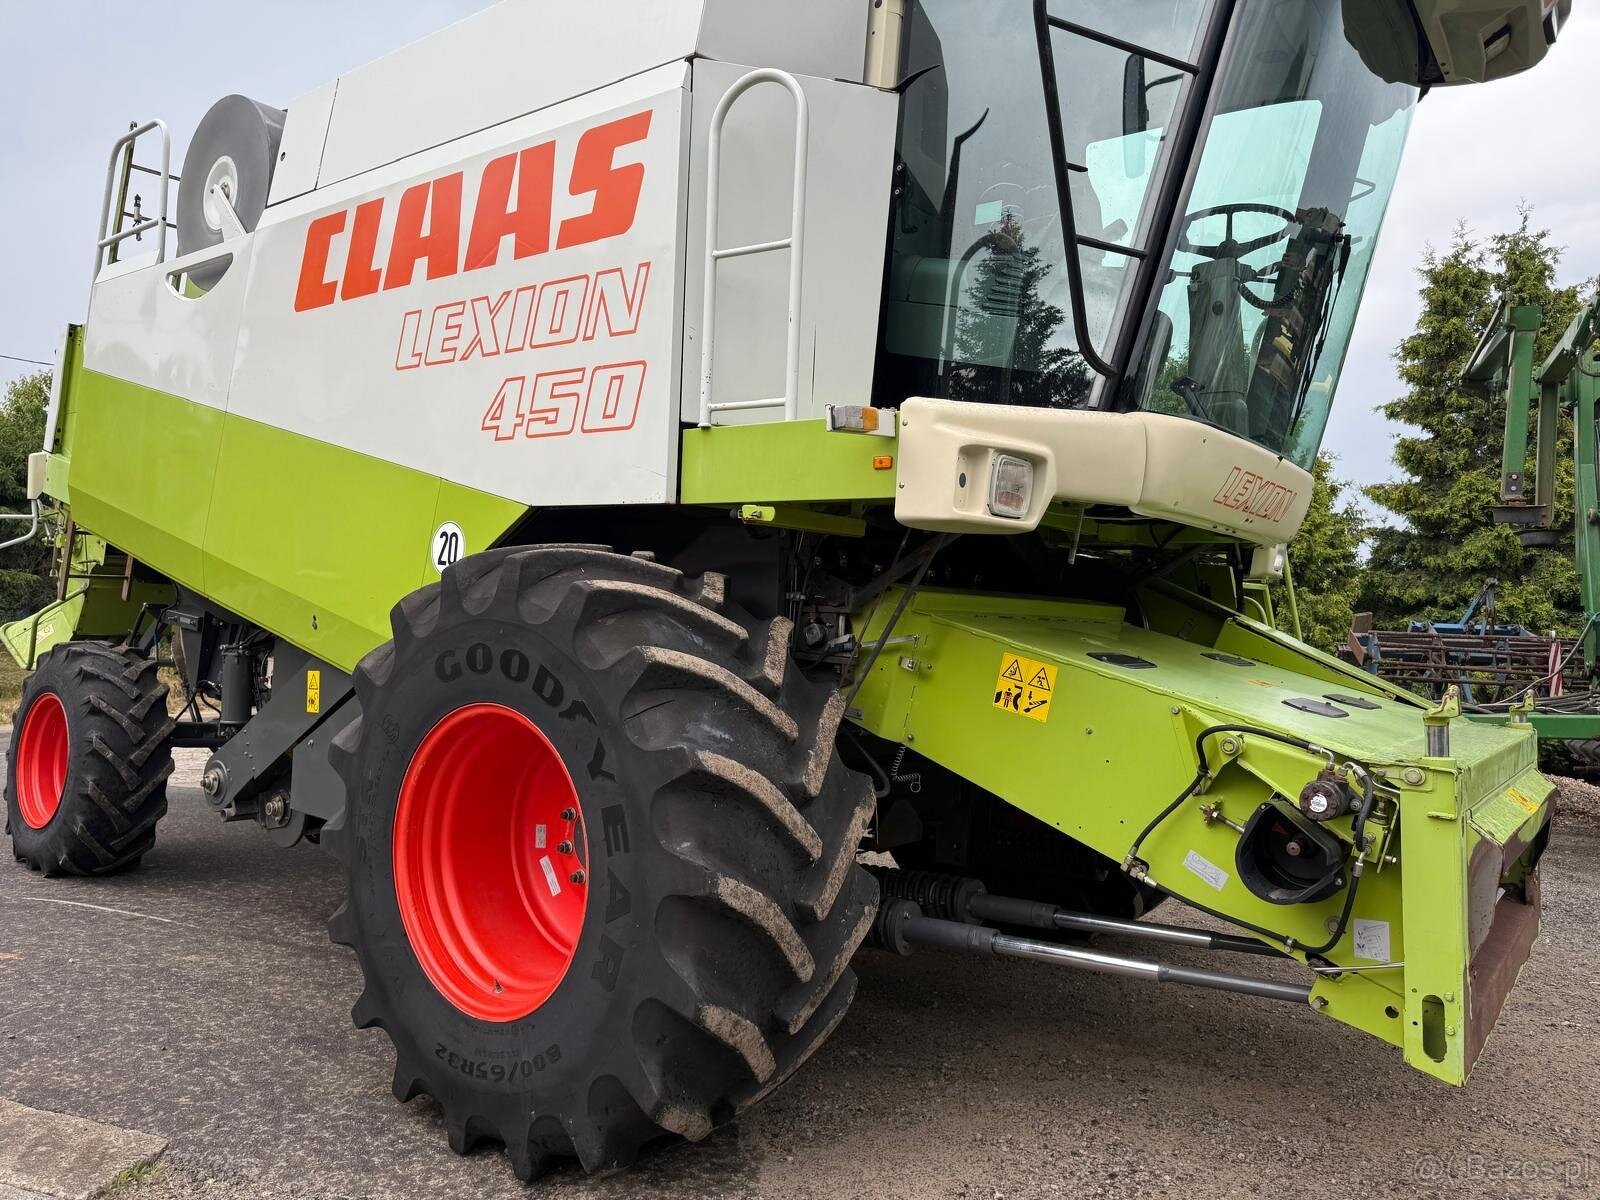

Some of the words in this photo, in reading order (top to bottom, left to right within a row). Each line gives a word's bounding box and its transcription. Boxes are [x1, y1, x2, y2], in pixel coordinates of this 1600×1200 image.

[294, 109, 653, 313] CLAAS
[395, 261, 651, 371] LEXION
[481, 360, 647, 441] 450
[1213, 466, 1298, 523] LEXION
[438, 531, 459, 566] 20
[434, 1042, 562, 1084] 800/65R32
